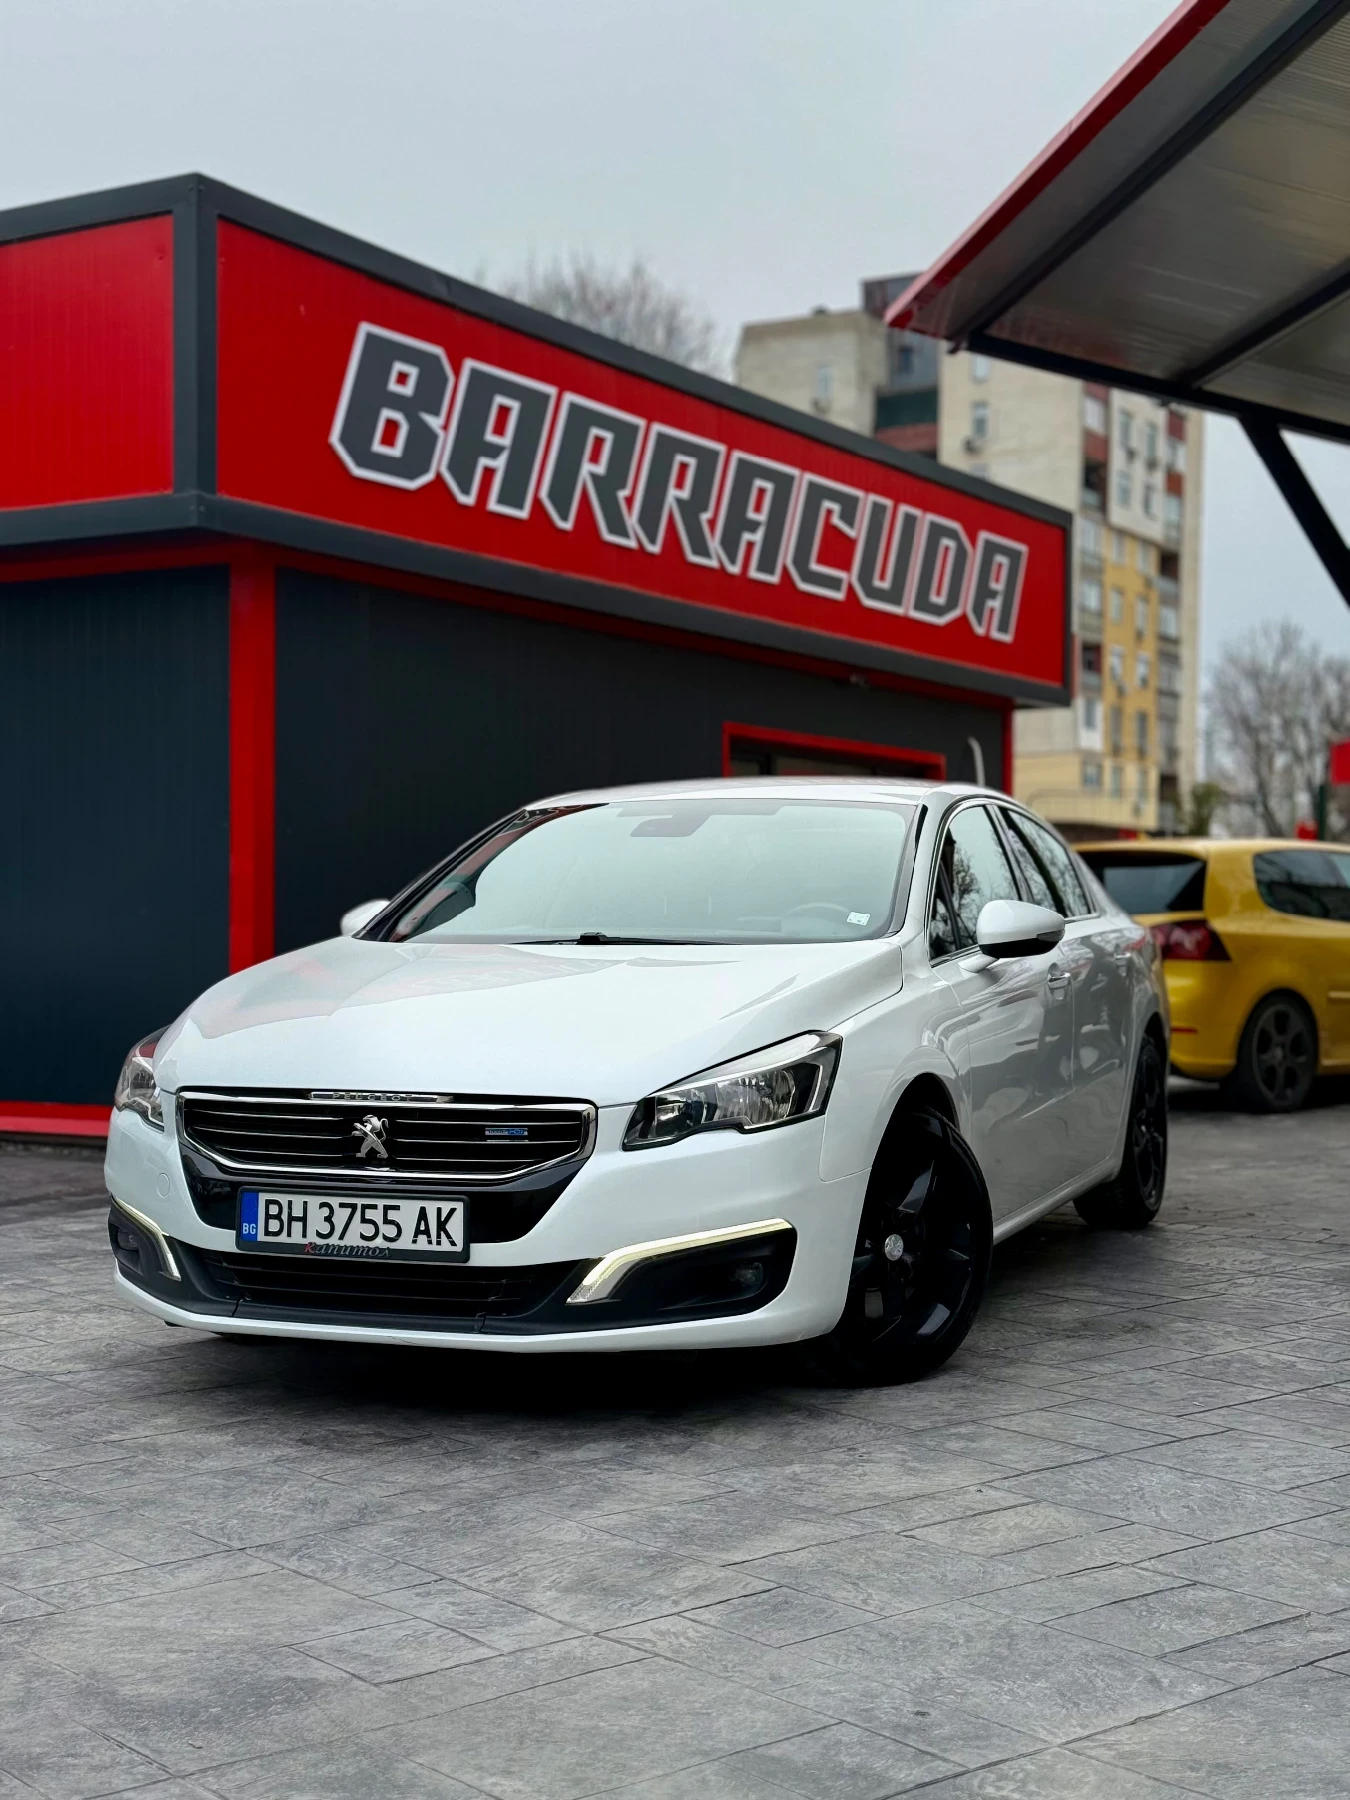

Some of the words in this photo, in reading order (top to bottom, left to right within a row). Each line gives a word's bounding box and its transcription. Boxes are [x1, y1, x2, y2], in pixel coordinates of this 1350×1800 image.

[329, 321, 1028, 643] BARRACUDA
[242, 1222, 257, 1235] BG
[263, 1198, 308, 1239] BH
[315, 1201, 402, 1243] 3755
[412, 1205, 458, 1247] AK
